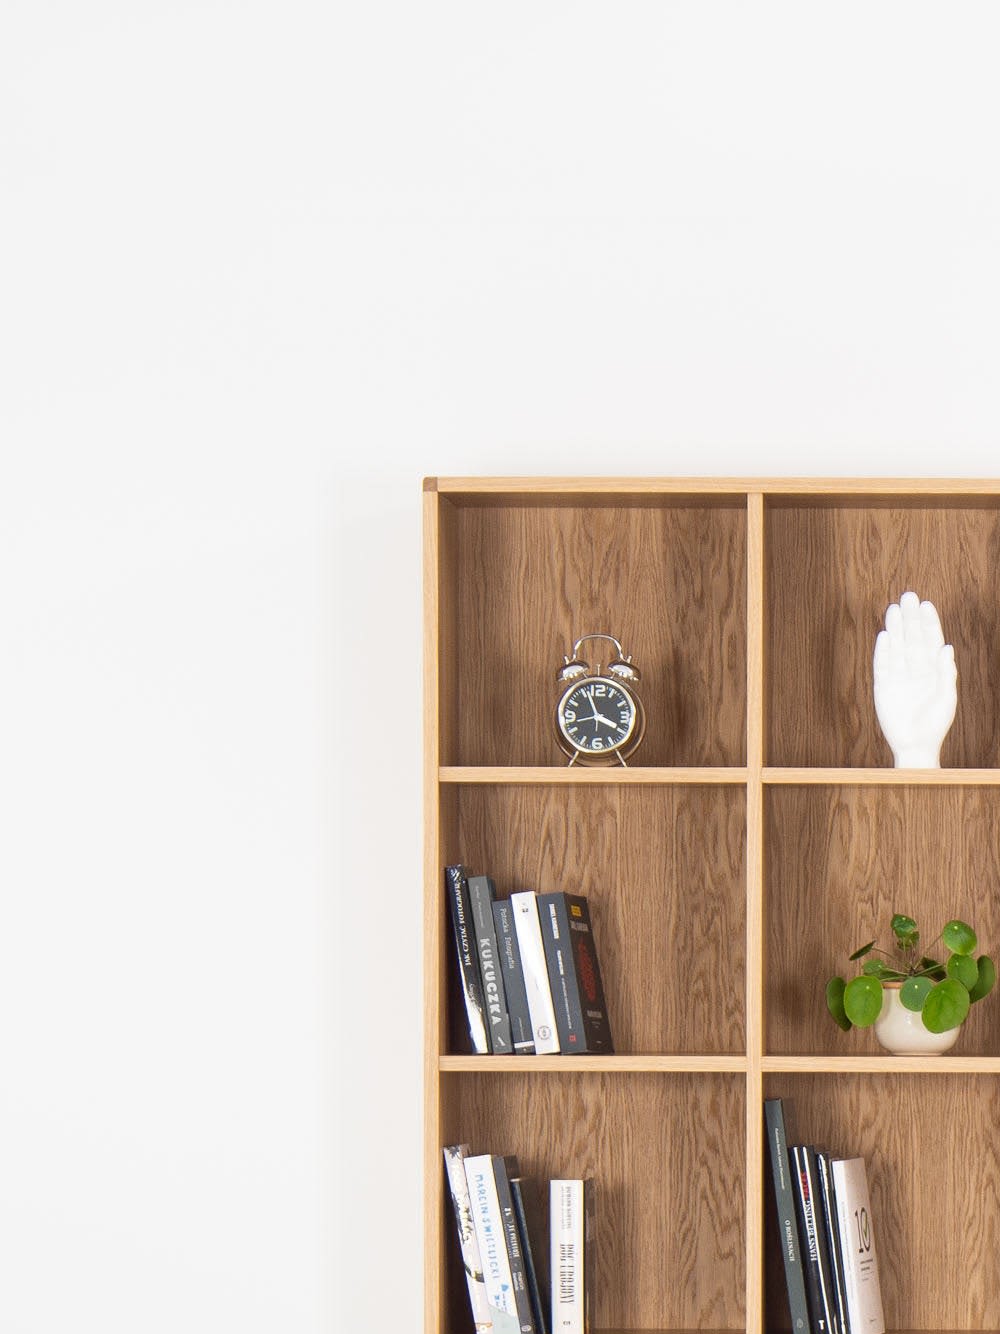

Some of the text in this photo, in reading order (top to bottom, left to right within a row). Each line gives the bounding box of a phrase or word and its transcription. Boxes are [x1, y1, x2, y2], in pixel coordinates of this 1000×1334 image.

[590, 684, 606, 696] 12
[564, 710, 576, 723] 9
[620, 711, 630, 723] 3
[591, 737, 603, 749] 6
[500, 907, 509, 933] Potocka
[480, 938, 502, 1025] KUKUCZKA
[475, 1174, 489, 1214] MARCIN
[808, 1238, 817, 1261] HANS
